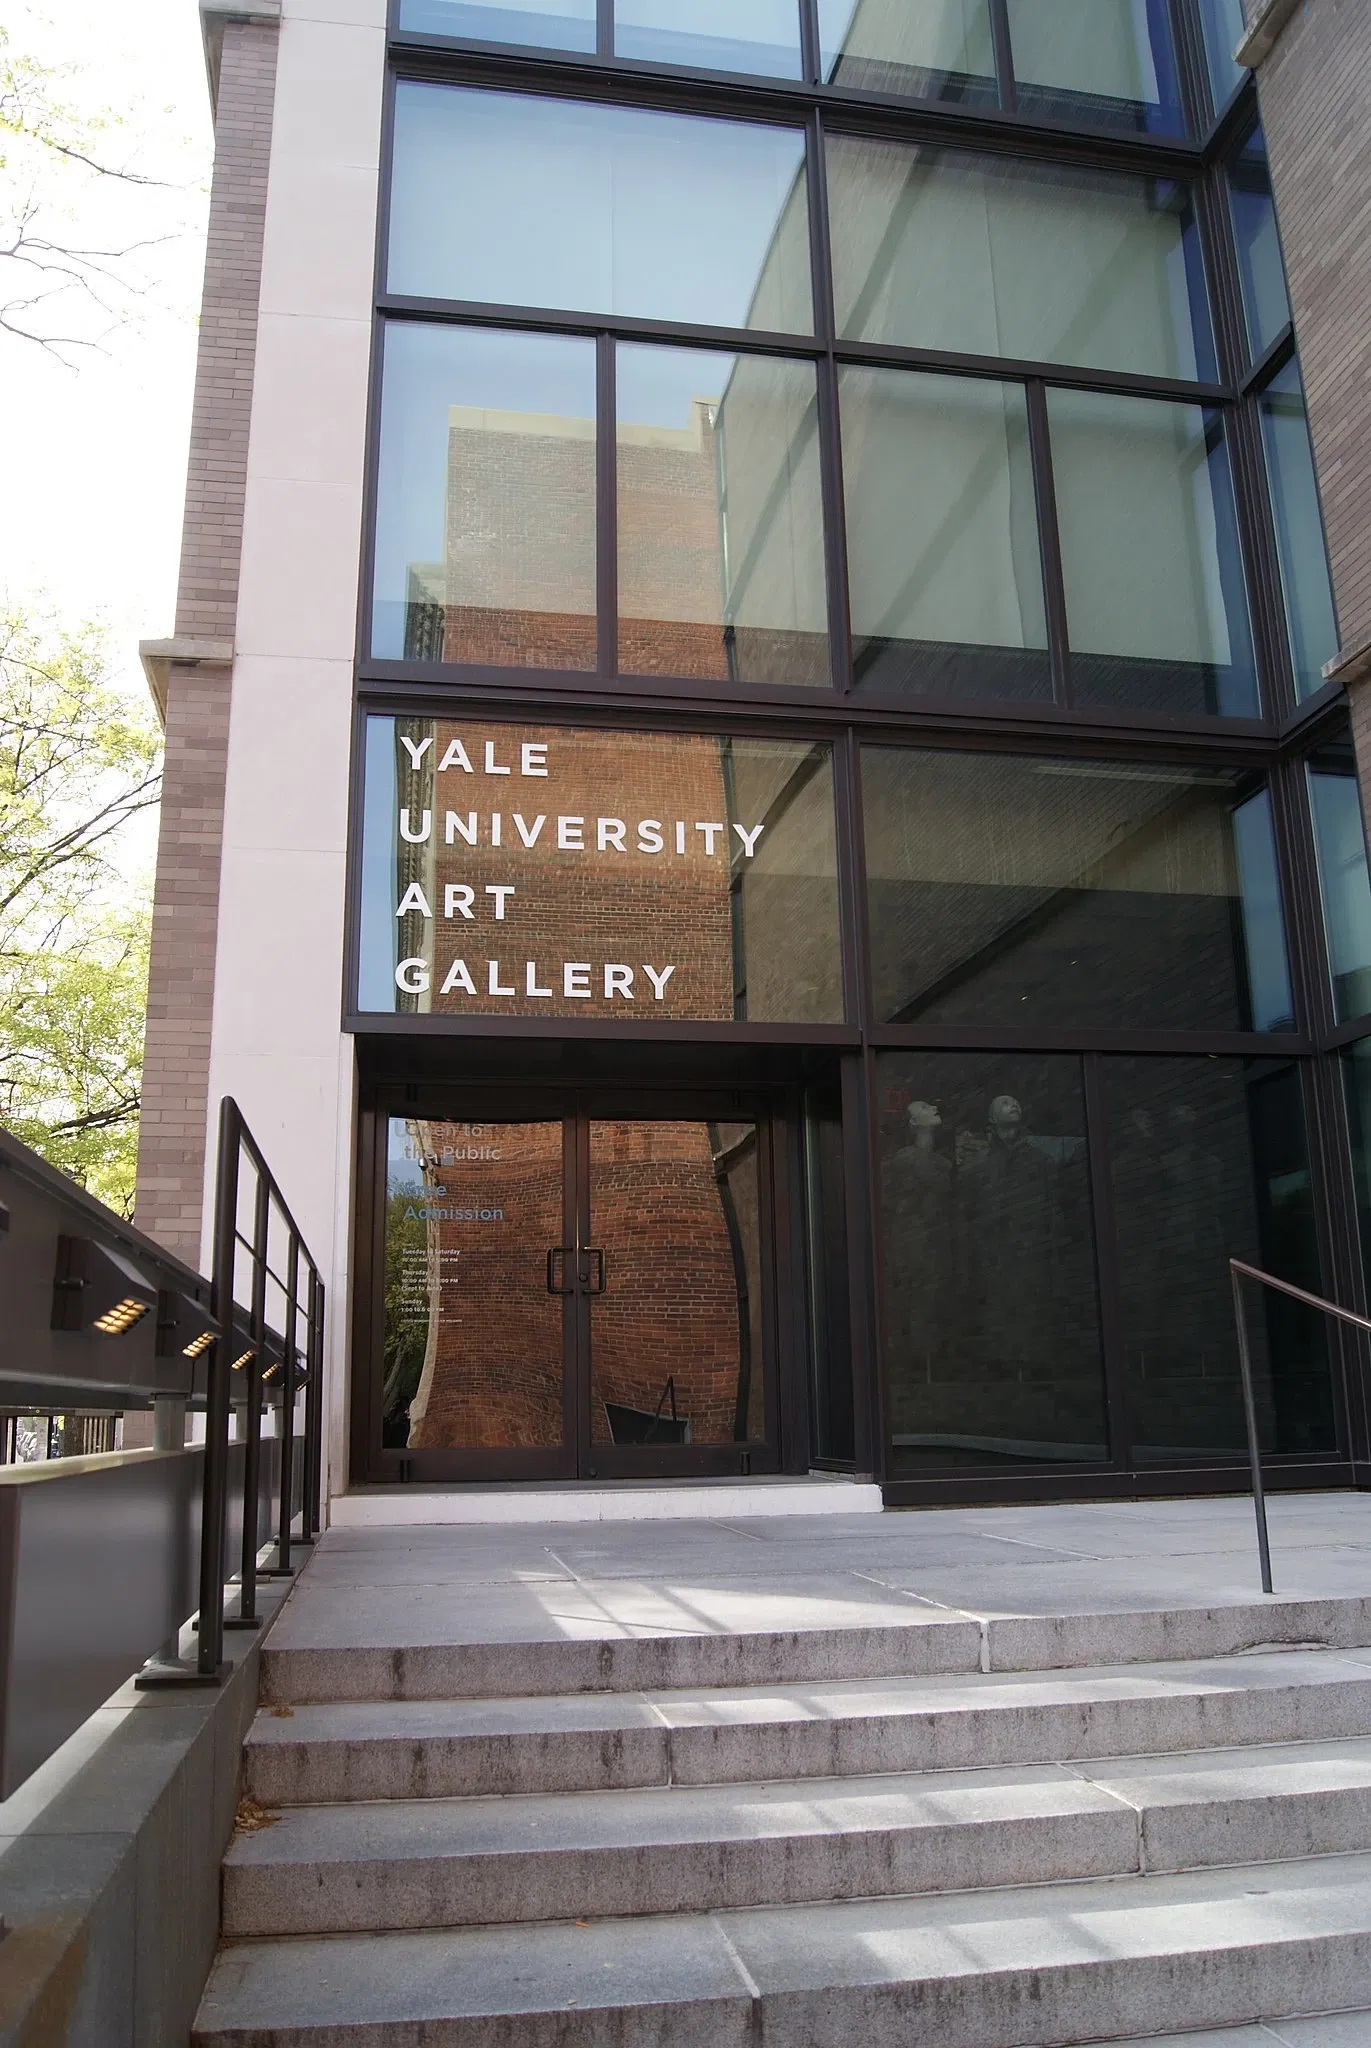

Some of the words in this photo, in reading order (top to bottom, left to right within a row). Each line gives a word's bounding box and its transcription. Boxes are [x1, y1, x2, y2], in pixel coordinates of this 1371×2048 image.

[400, 736, 548, 777] YALE
[399, 808, 765, 858] UNIVERSITY
[395, 882, 516, 920] ART
[394, 957, 676, 1001] GALLERY
[465, 1125, 482, 1137] to
[404, 1144, 434, 1160] the
[442, 1144, 501, 1160] Public
[404, 1205, 504, 1221] Admission
